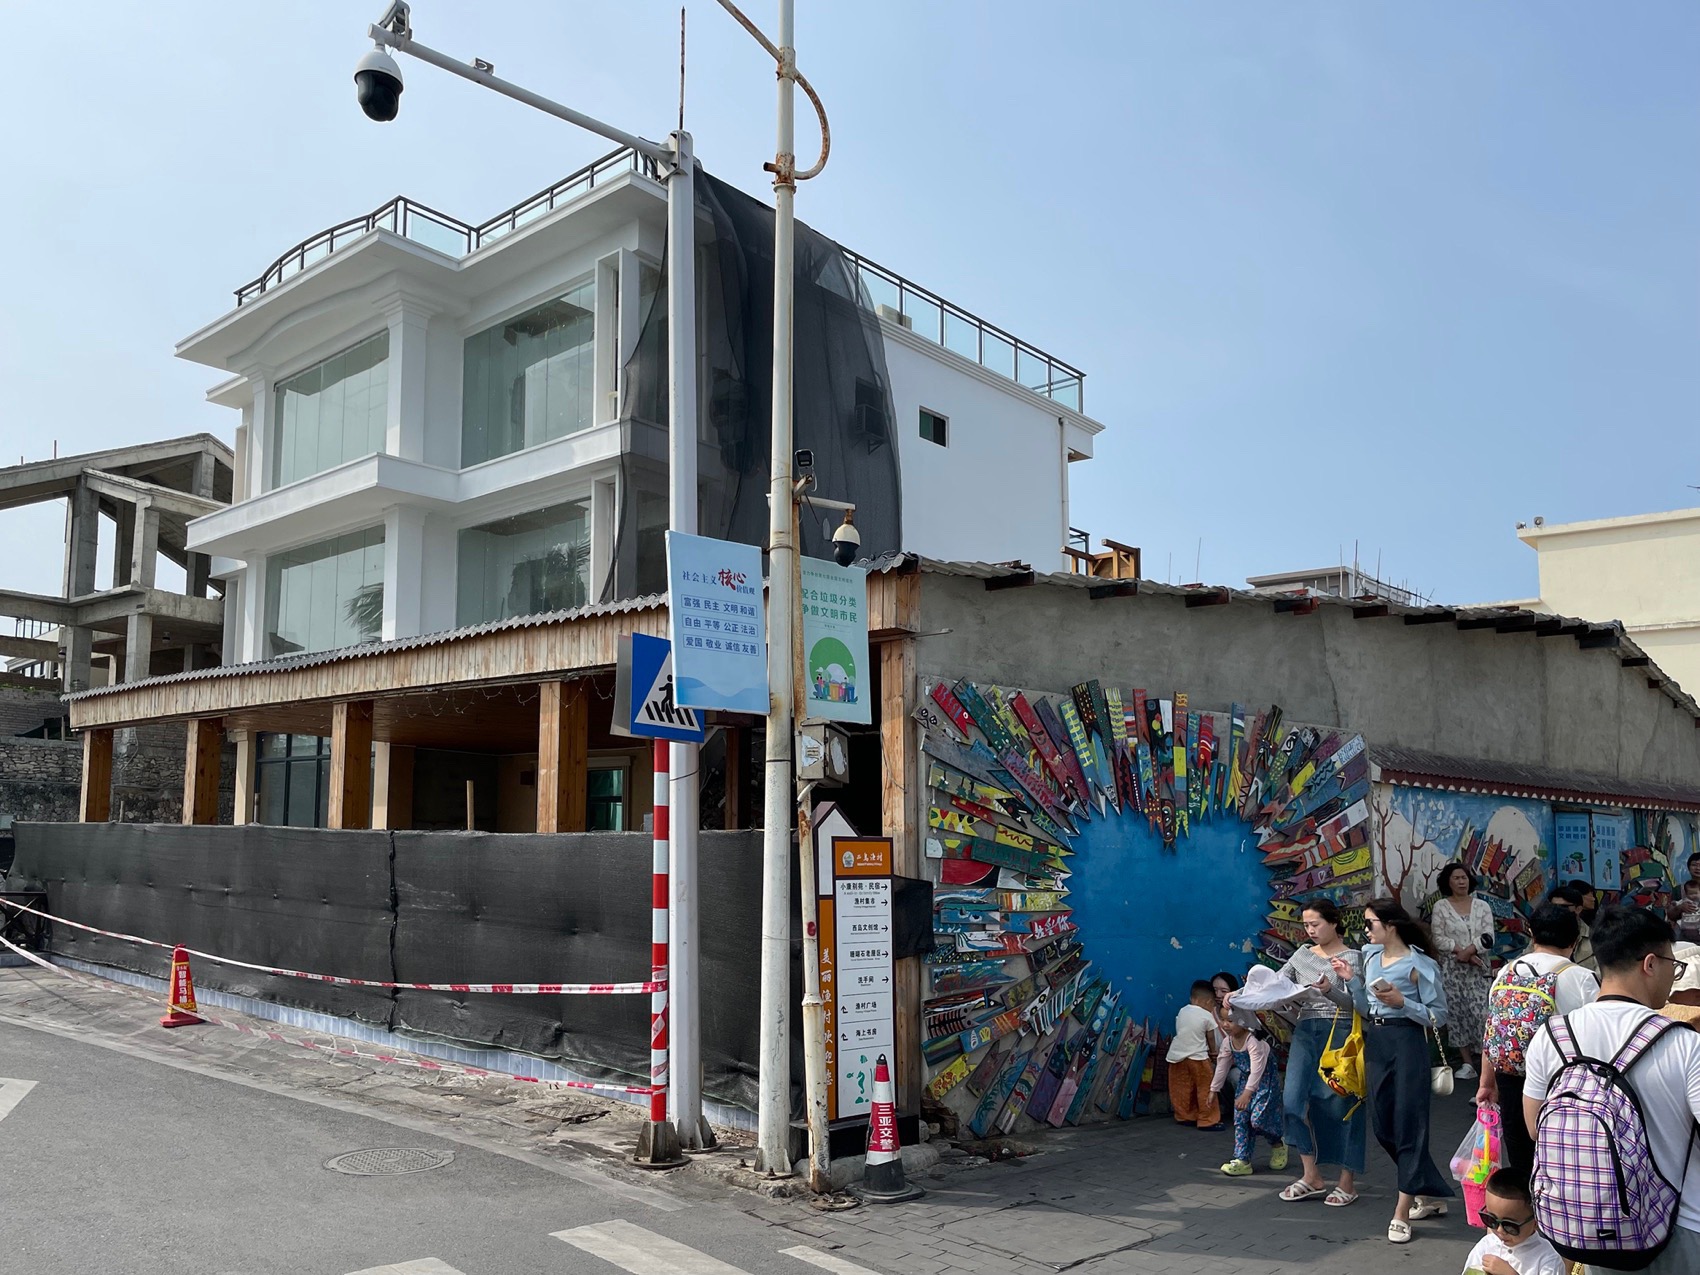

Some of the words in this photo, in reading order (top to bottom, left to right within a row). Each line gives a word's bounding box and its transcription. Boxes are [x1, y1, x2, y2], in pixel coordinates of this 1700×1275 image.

[683, 571, 717, 585] 社会主义
[718, 568, 747, 590] 核心
[736, 584, 755, 595] 价值观
[684, 597, 701, 609] 富强
[704, 600, 720, 611] 民主
[723, 603, 738, 614] 文明
[740, 605, 755, 617] 和谐
[801, 588, 857, 608] 配合垃圾分类
[801, 603, 857, 623] 争做文明市民
[685, 617, 701, 628] 自由
[704, 619, 720, 630] 平等
[723, 622, 739, 633] 公正
[741, 624, 756, 635] 法治
[686, 636, 702, 647] 爱国
[705, 638, 722, 650] 敬业
[725, 641, 740, 652] 诚信
[742, 643, 757, 655] 友善
[858, 976, 874, 984] 洗手间
[855, 1001, 877, 1010] 渔村广场
